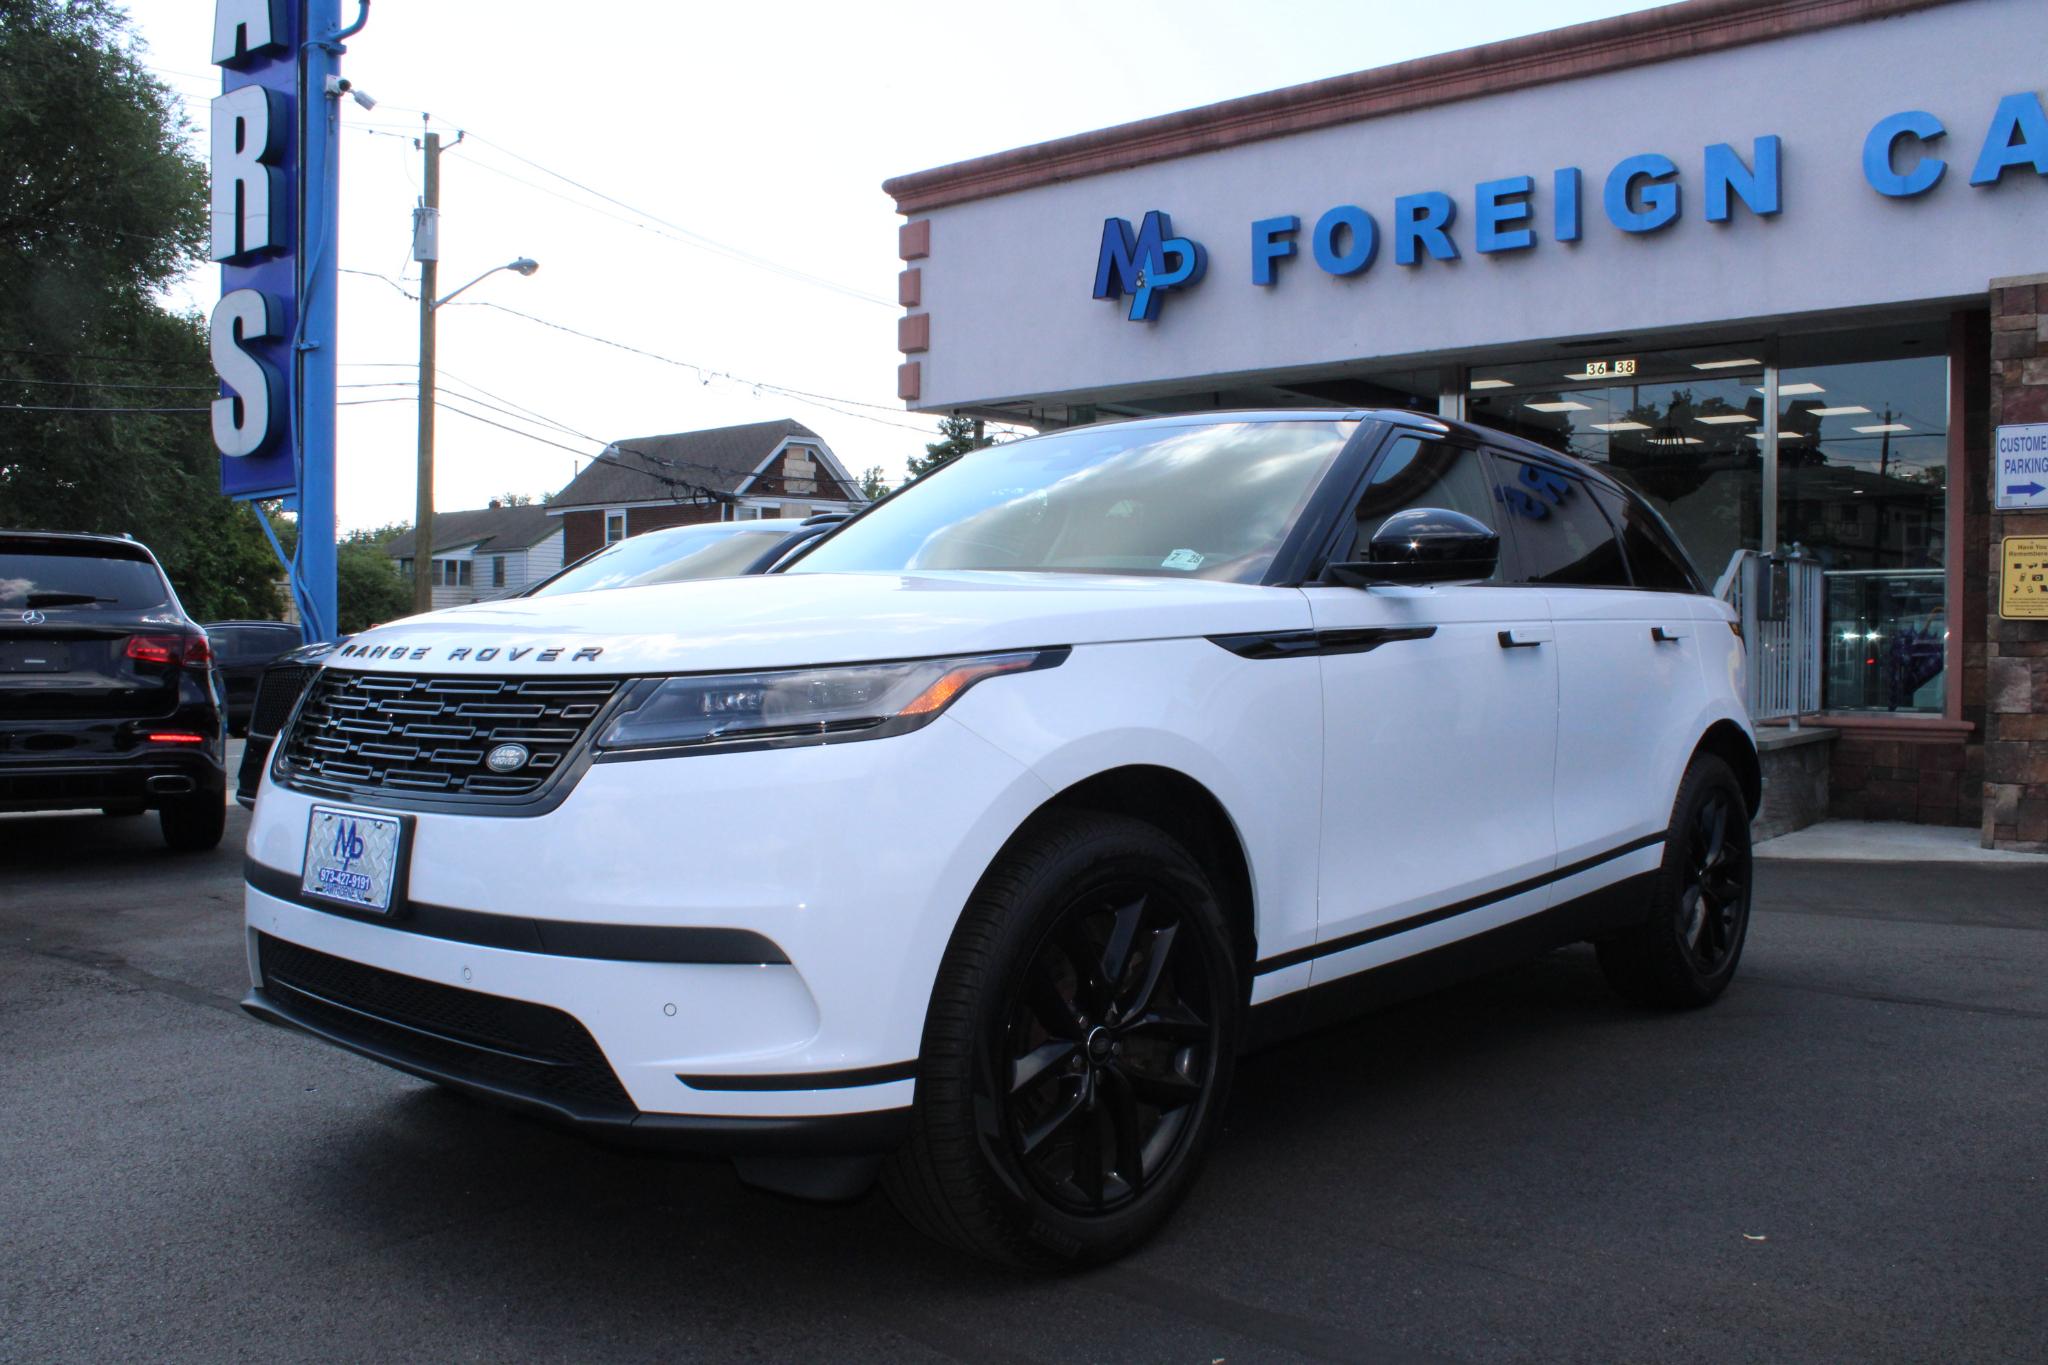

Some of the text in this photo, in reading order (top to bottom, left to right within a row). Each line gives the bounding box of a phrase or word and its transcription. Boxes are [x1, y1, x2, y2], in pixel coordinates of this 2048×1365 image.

[1251, 134, 1783, 286] FOREIGN
[1863, 91, 2048, 198] CA
[1587, 360, 1635, 376] 36 38
[2000, 435, 2048, 453] CUSTOME
[2004, 457, 2048, 474] PARKING
[340, 644, 604, 662] RANGE ROVER
[320, 868, 370, 890] 973-427-9191
